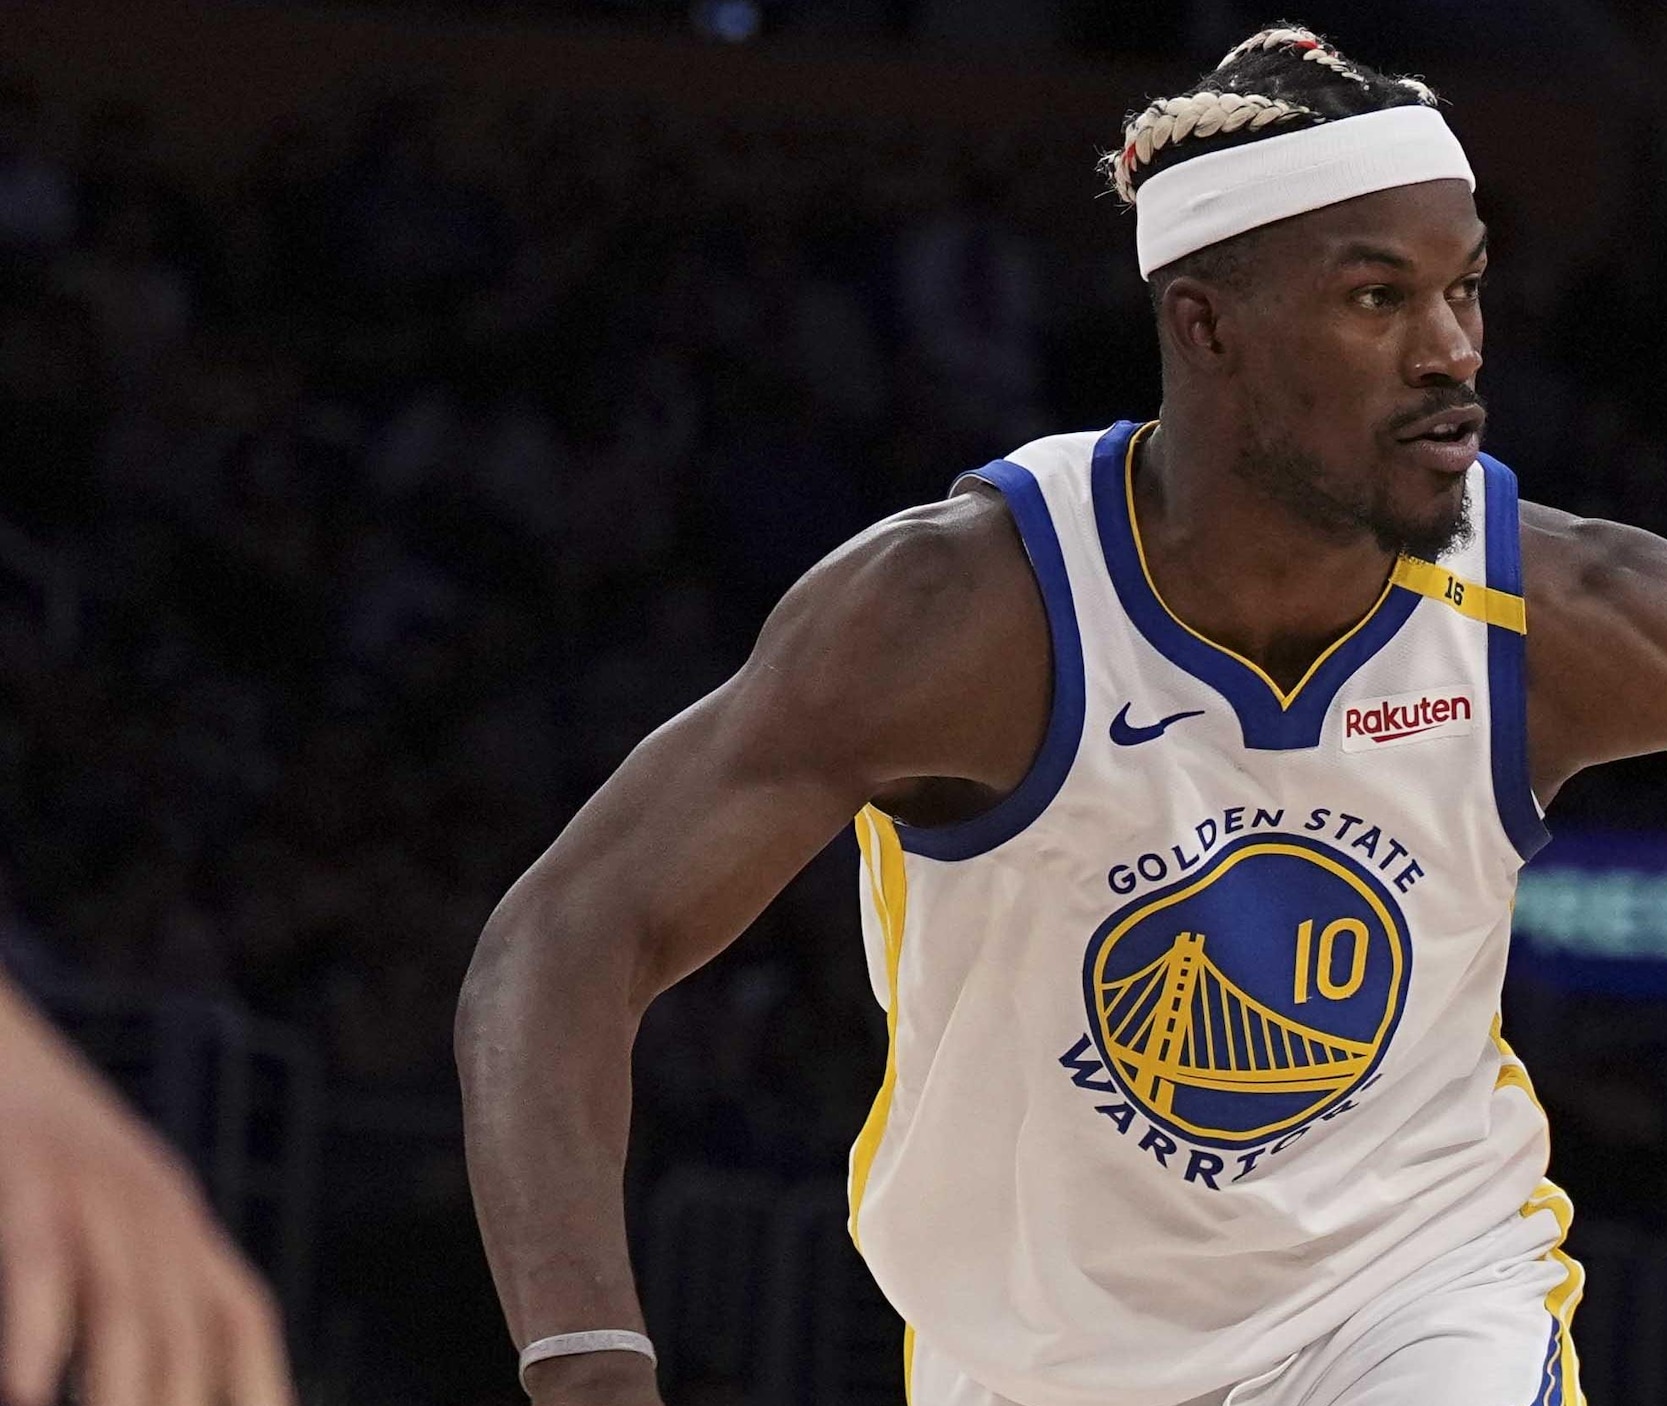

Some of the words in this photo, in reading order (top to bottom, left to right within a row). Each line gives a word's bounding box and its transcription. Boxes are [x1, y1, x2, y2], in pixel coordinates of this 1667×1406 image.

[1444, 576, 1465, 606] 16
[1345, 696, 1472, 740] Rakuten
[1107, 806, 1285, 895] GOLDEN
[1303, 807, 1426, 894] STATE
[1294, 917, 1370, 1005] 10
